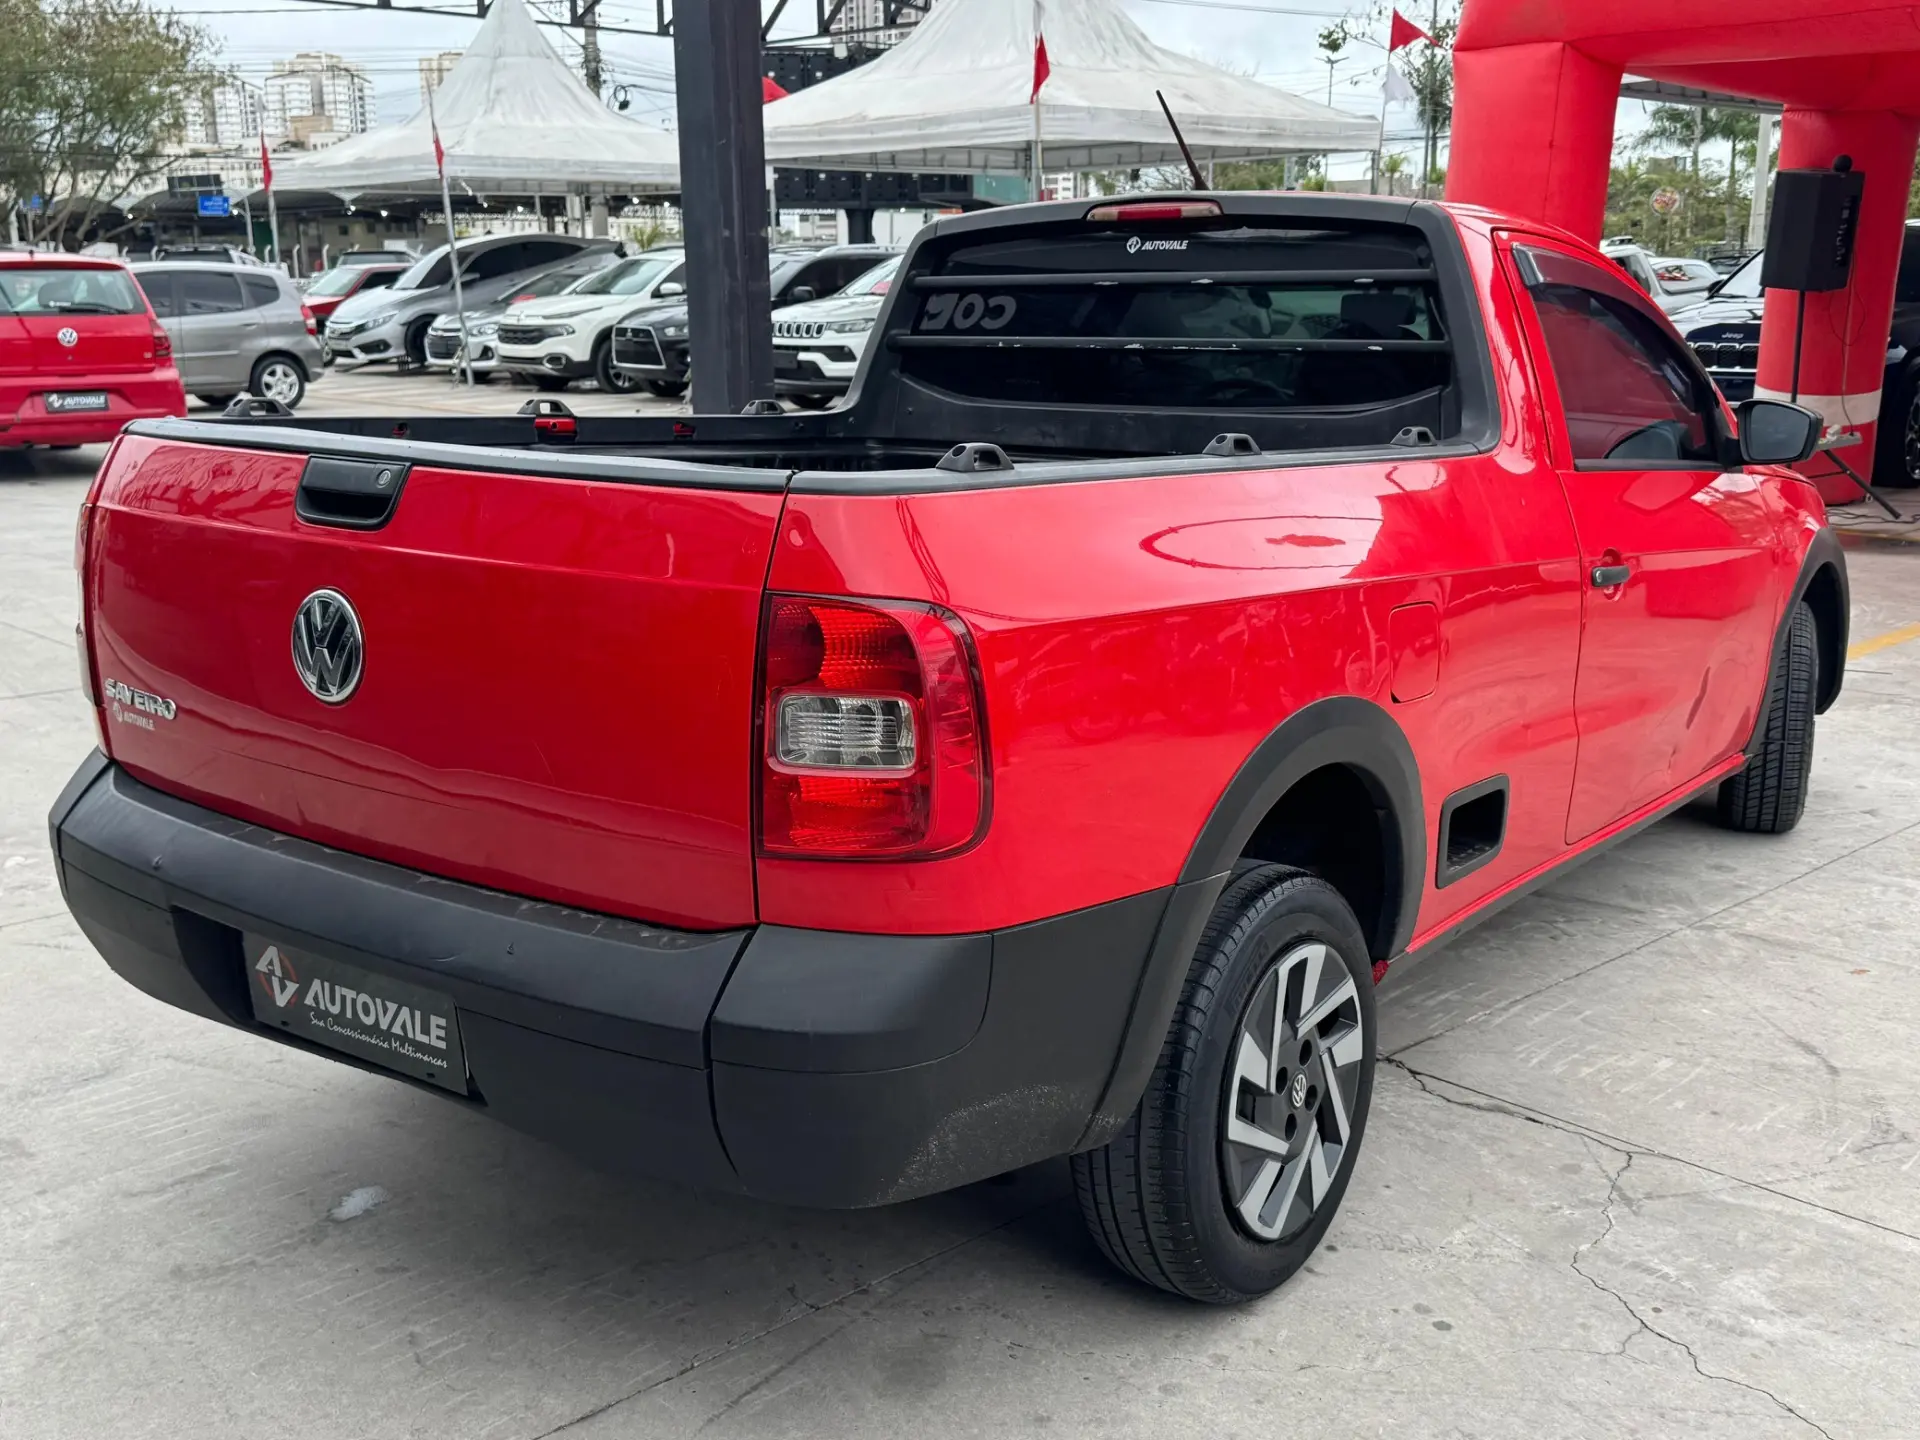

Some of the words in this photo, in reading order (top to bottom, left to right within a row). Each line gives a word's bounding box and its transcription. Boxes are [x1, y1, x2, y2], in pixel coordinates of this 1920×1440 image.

[1141, 240, 1189, 250] AUTOVALE
[63, 395, 105, 405] AUTOVALE
[105, 678, 176, 720] SAVEIRO
[304, 978, 446, 1049] AUTOVALE
[310, 1011, 325, 1027] Sua
[391, 1038, 448, 1069] Multimarcas
